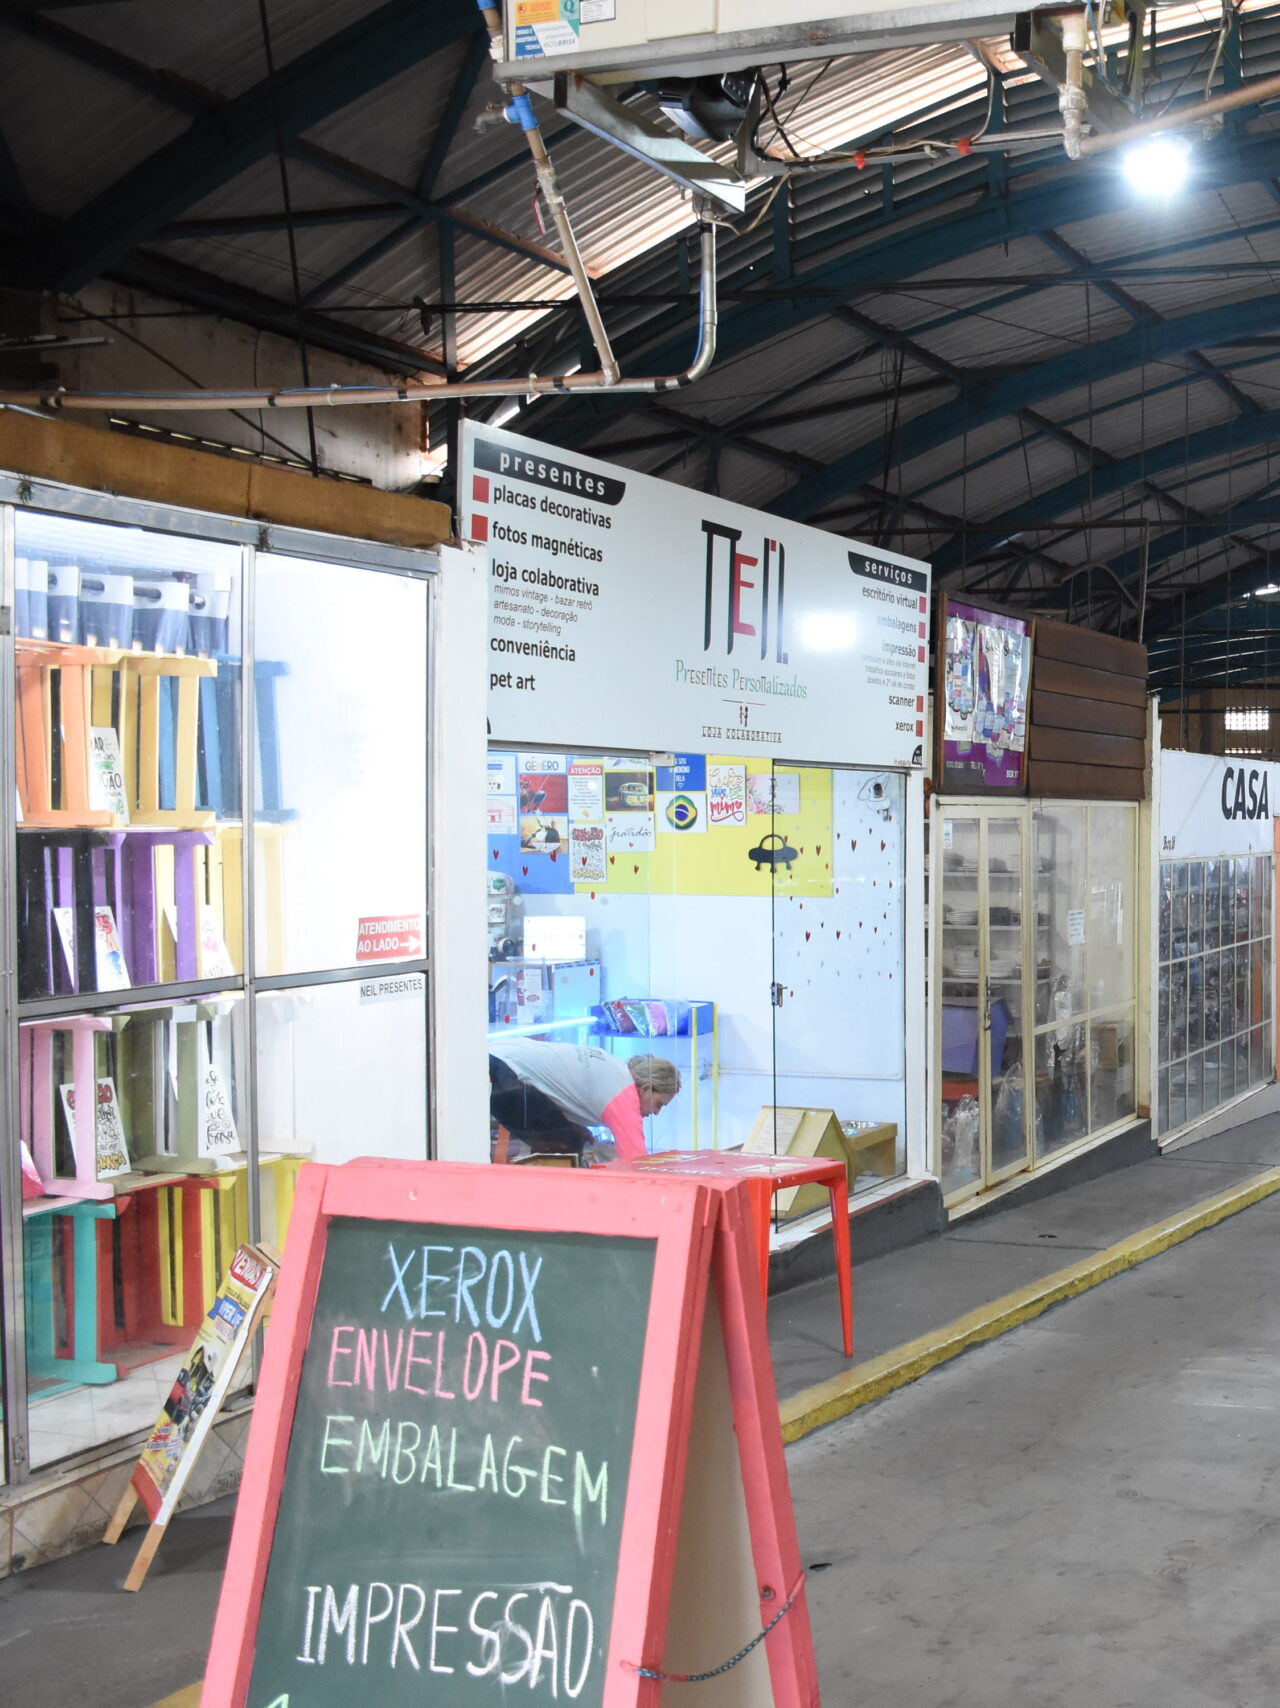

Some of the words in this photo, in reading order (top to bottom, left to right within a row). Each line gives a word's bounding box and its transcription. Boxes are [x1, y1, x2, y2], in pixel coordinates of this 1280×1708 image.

[500, 452, 606, 496] presentes
[494, 485, 536, 510] placas
[540, 496, 612, 529] decorativas
[492, 521, 527, 545] fotos
[531, 534, 603, 562] magnéticas
[492, 558, 517, 583] loja
[522, 568, 600, 597] colaborativa
[865, 560, 913, 584] serviços
[494, 584, 519, 598] mimos
[522, 589, 548, 605] vintage
[862, 586, 896, 606] escritório
[896, 593, 918, 610] virtual
[494, 600, 534, 615] artesanato
[541, 608, 578, 622] decoração
[494, 615, 516, 627] moda
[490, 637, 576, 662] conveniência
[882, 641, 916, 658] impressão
[490, 671, 512, 691] pet
[517, 675, 535, 691] art
[888, 694, 915, 708] scanner
[895, 720, 914, 733] xerox
[570, 766, 602, 776] ATENÇÃO
[1222, 766, 1270, 821] CASA
[360, 919, 421, 936] ATENDIMENTO
[358, 940, 371, 953] AO
[373, 938, 399, 952] LADO
[360, 985, 378, 997] NEIL
[379, 978, 423, 995] PRESENTES
[380, 1242, 543, 1343] XEROX
[327, 1325, 553, 1408] ENVELOPE
[320, 1415, 609, 1526] EMBALAGEM
[297, 1580, 594, 1699] IMPRESSÃO
